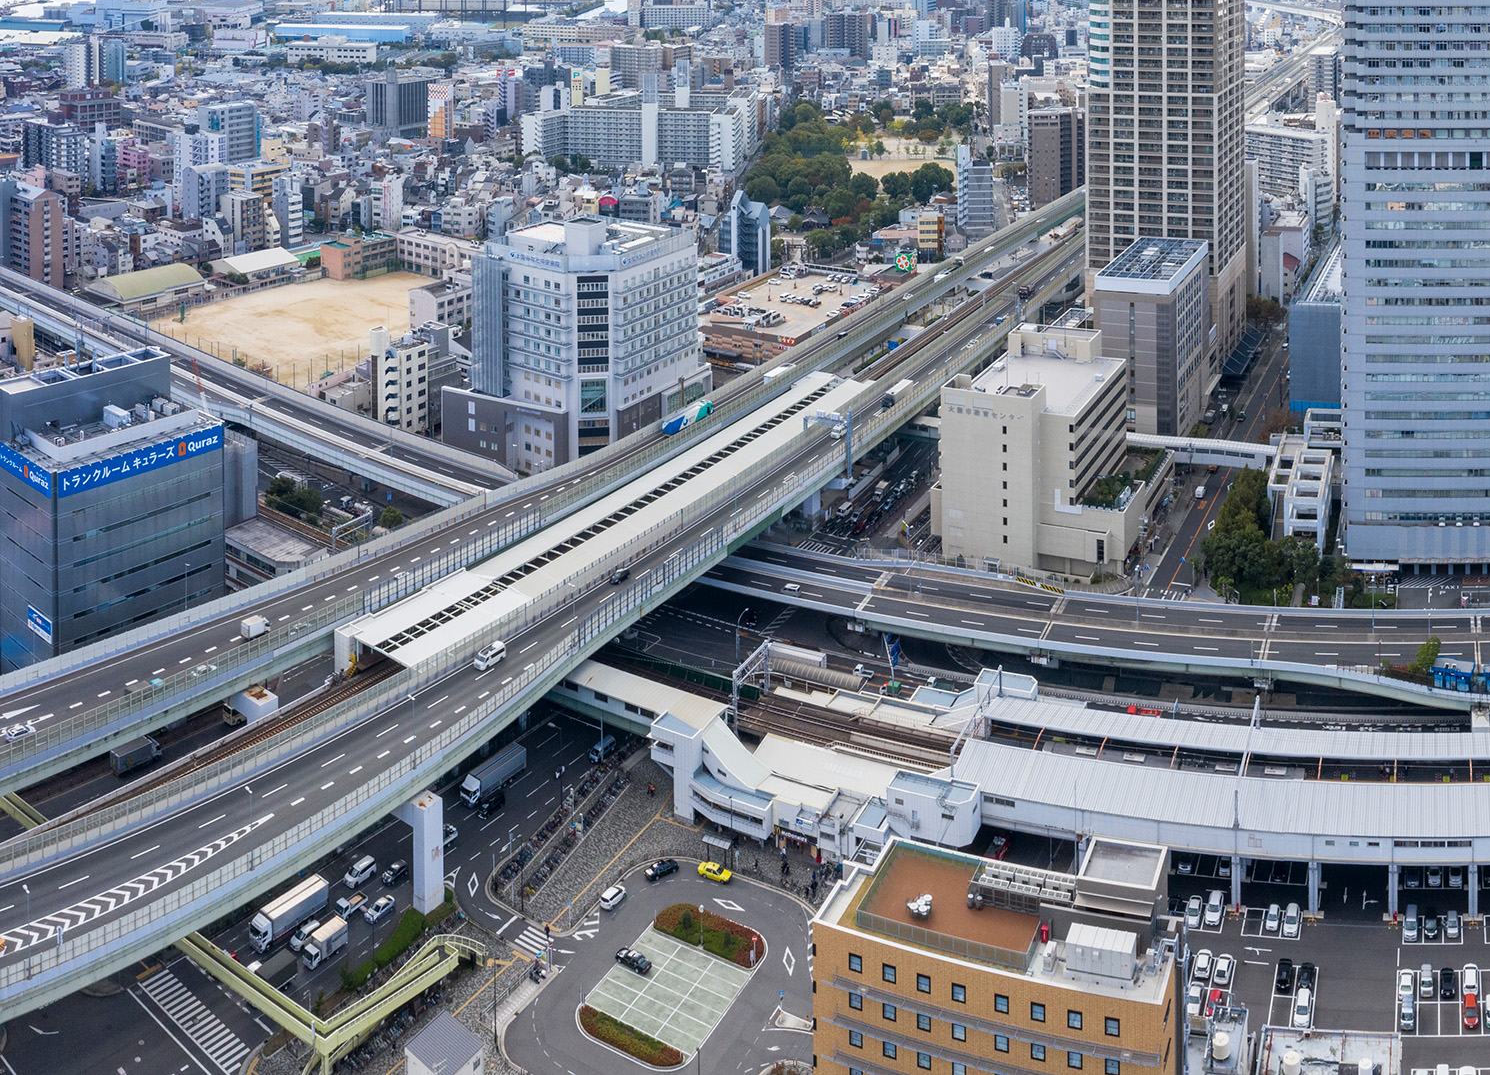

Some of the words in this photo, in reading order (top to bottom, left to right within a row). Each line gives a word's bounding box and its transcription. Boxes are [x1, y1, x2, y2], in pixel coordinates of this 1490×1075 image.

[948, 405, 1024, 421] 大阪市教育センター
[63, 461, 130, 491] トランクルーム
[132, 445, 175, 469] キュラーズ
[187, 434, 219, 452] Quraz
[29, 471, 49, 490] Quraz
